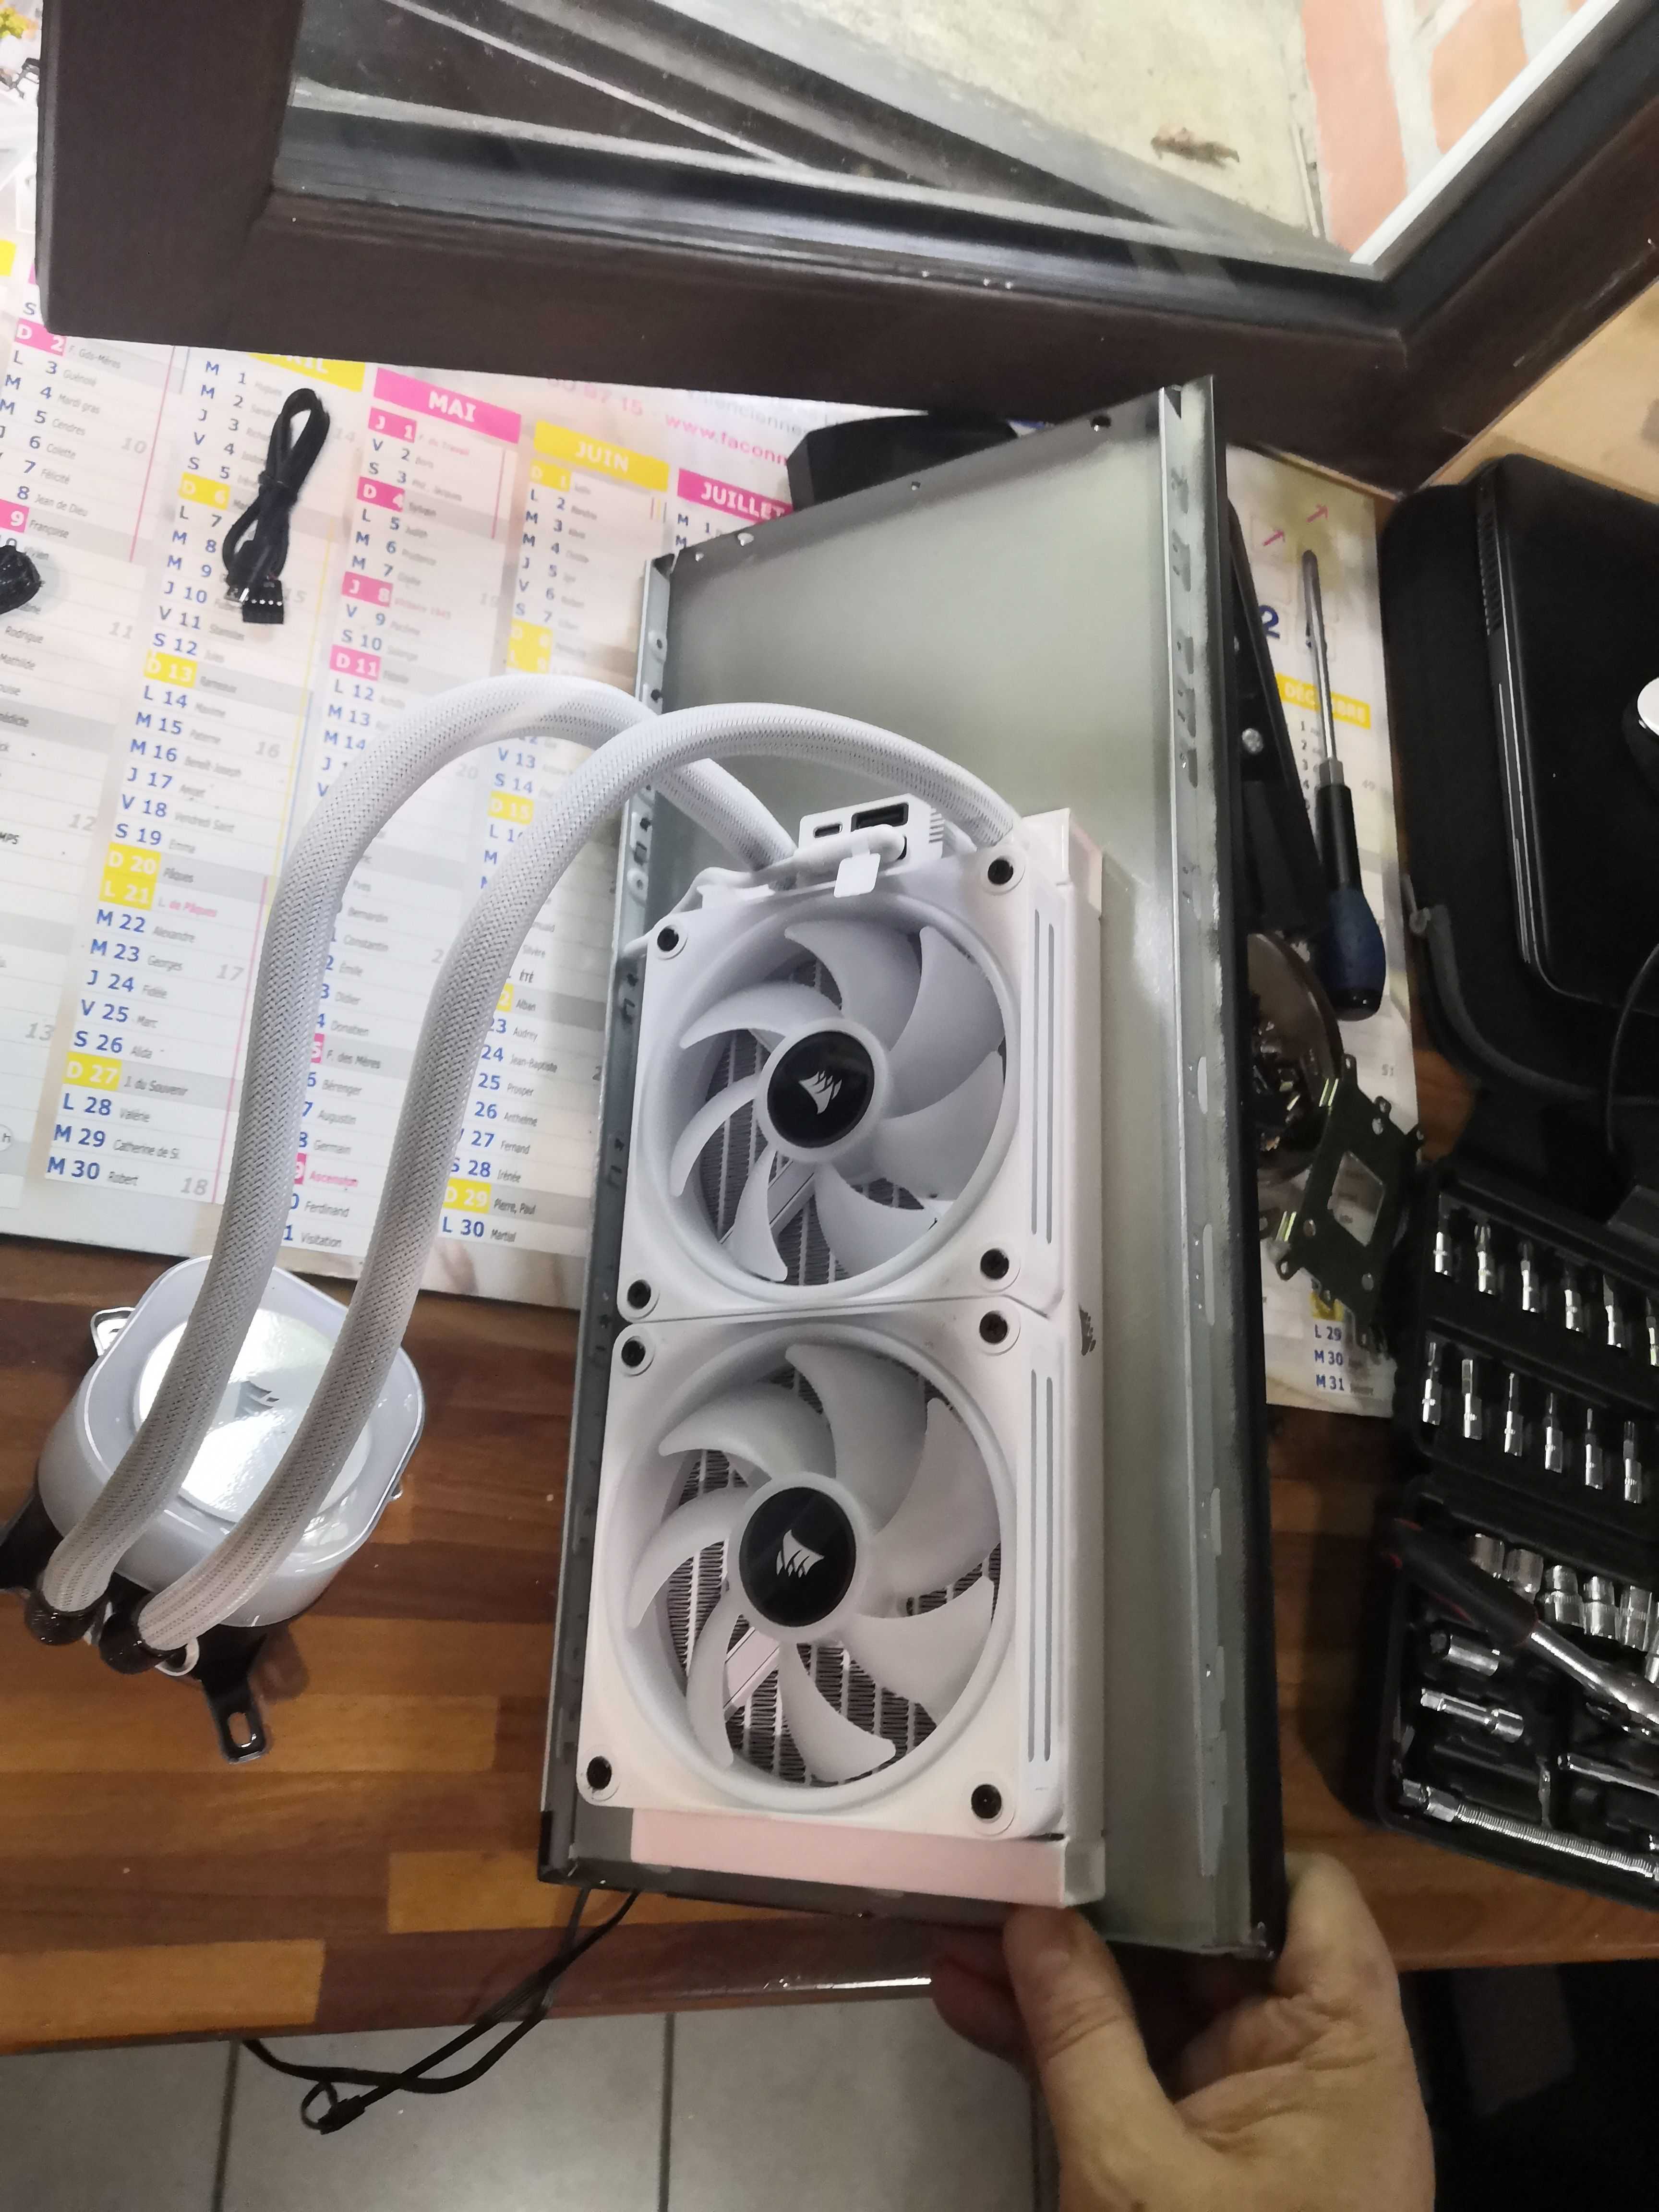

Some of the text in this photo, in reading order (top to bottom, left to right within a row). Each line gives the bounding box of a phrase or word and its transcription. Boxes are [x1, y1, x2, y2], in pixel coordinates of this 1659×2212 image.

[23, 302, 36, 315] S
[206, 361, 246, 384] M 1
[5, 374, 21, 390] M
[40, 387, 52, 398] 4
[201, 385, 243, 408] M 2
[0, 399, 15, 415] M
[35, 410, 47, 423] 5
[428, 391, 476, 422] MAI
[198, 409, 239, 431] J 3
[121, 438, 147, 454] 10
[194, 432, 234, 455] V 4
[373, 439, 410, 461] V 2
[24, 460, 36, 473] 7
[188, 457, 229, 480] S 5
[576, 442, 629, 473] JUIN
[17, 486, 29, 500] 8
[531, 489, 565, 510] L 2
[701, 482, 784, 519] JUILLET
[11, 511, 24, 526] 9
[526, 511, 563, 532] M 3
[678, 514, 688, 526] M
[172, 530, 216, 553] M 8
[356, 531, 396, 553] M 6
[523, 534, 560, 554] M 4
[168, 555, 212, 577] M 9
[352, 555, 393, 577] M 7
[164, 582, 207, 603] J 10
[519, 580, 554, 601] V 6
[160, 606, 200, 629] V 11
[347, 604, 385, 626] V 9
[516, 602, 553, 622] S 7
[109, 622, 133, 639] 11
[341, 629, 382, 651] S 10
[153, 634, 198, 656] S 12
[147, 659, 192, 681] D 13
[337, 653, 376, 676] D 11
[144, 685, 187, 708] L 14
[335, 679, 374, 701] L 12
[136, 712, 183, 734] M 15
[328, 704, 370, 726] M 13
[1301, 721, 1305, 731] 1
[131, 739, 177, 762] M 16
[324, 730, 365, 750] M 14
[498, 747, 535, 768] V 13
[127, 768, 172, 789] J 17
[495, 773, 533, 793] S 14
[69, 814, 96, 831] 12
[108, 853, 123, 868] D
[130, 856, 156, 875] 20
[97, 909, 113, 926] M
[120, 914, 145, 933] 22
[90, 939, 107, 956] M
[114, 943, 140, 962] 23
[87, 970, 98, 985] J
[108, 974, 134, 992] 24
[216, 964, 244, 981] 17
[81, 999, 95, 1016] V
[102, 1004, 129, 1022] 25
[25, 1022, 56, 1041] 13
[74, 1031, 88, 1047] S
[96, 1034, 122, 1053] 26
[481, 1045, 503, 1061] 24
[478, 1073, 500, 1090] 25
[63, 1093, 74, 1110] L
[84, 1097, 111, 1116] 28
[475, 1102, 497, 1119] 26
[54, 1124, 72, 1142] M
[78, 1129, 106, 1147] 29
[471, 1131, 494, 1147] 27
[48, 1157, 65, 1175] M
[72, 1160, 100, 1180] 30
[180, 1178, 207, 1195] 18
[446, 1187, 457, 1202] D
[464, 1189, 487, 1208] 29
[520, 1203, 536, 1214] Paul
[443, 1216, 452, 1233] L
[461, 1219, 484, 1237] 30
[1314, 1325, 1342, 1341] L 29
[1314, 1350, 1343, 1365] M 30
[1316, 1374, 1344, 1390] M 31
